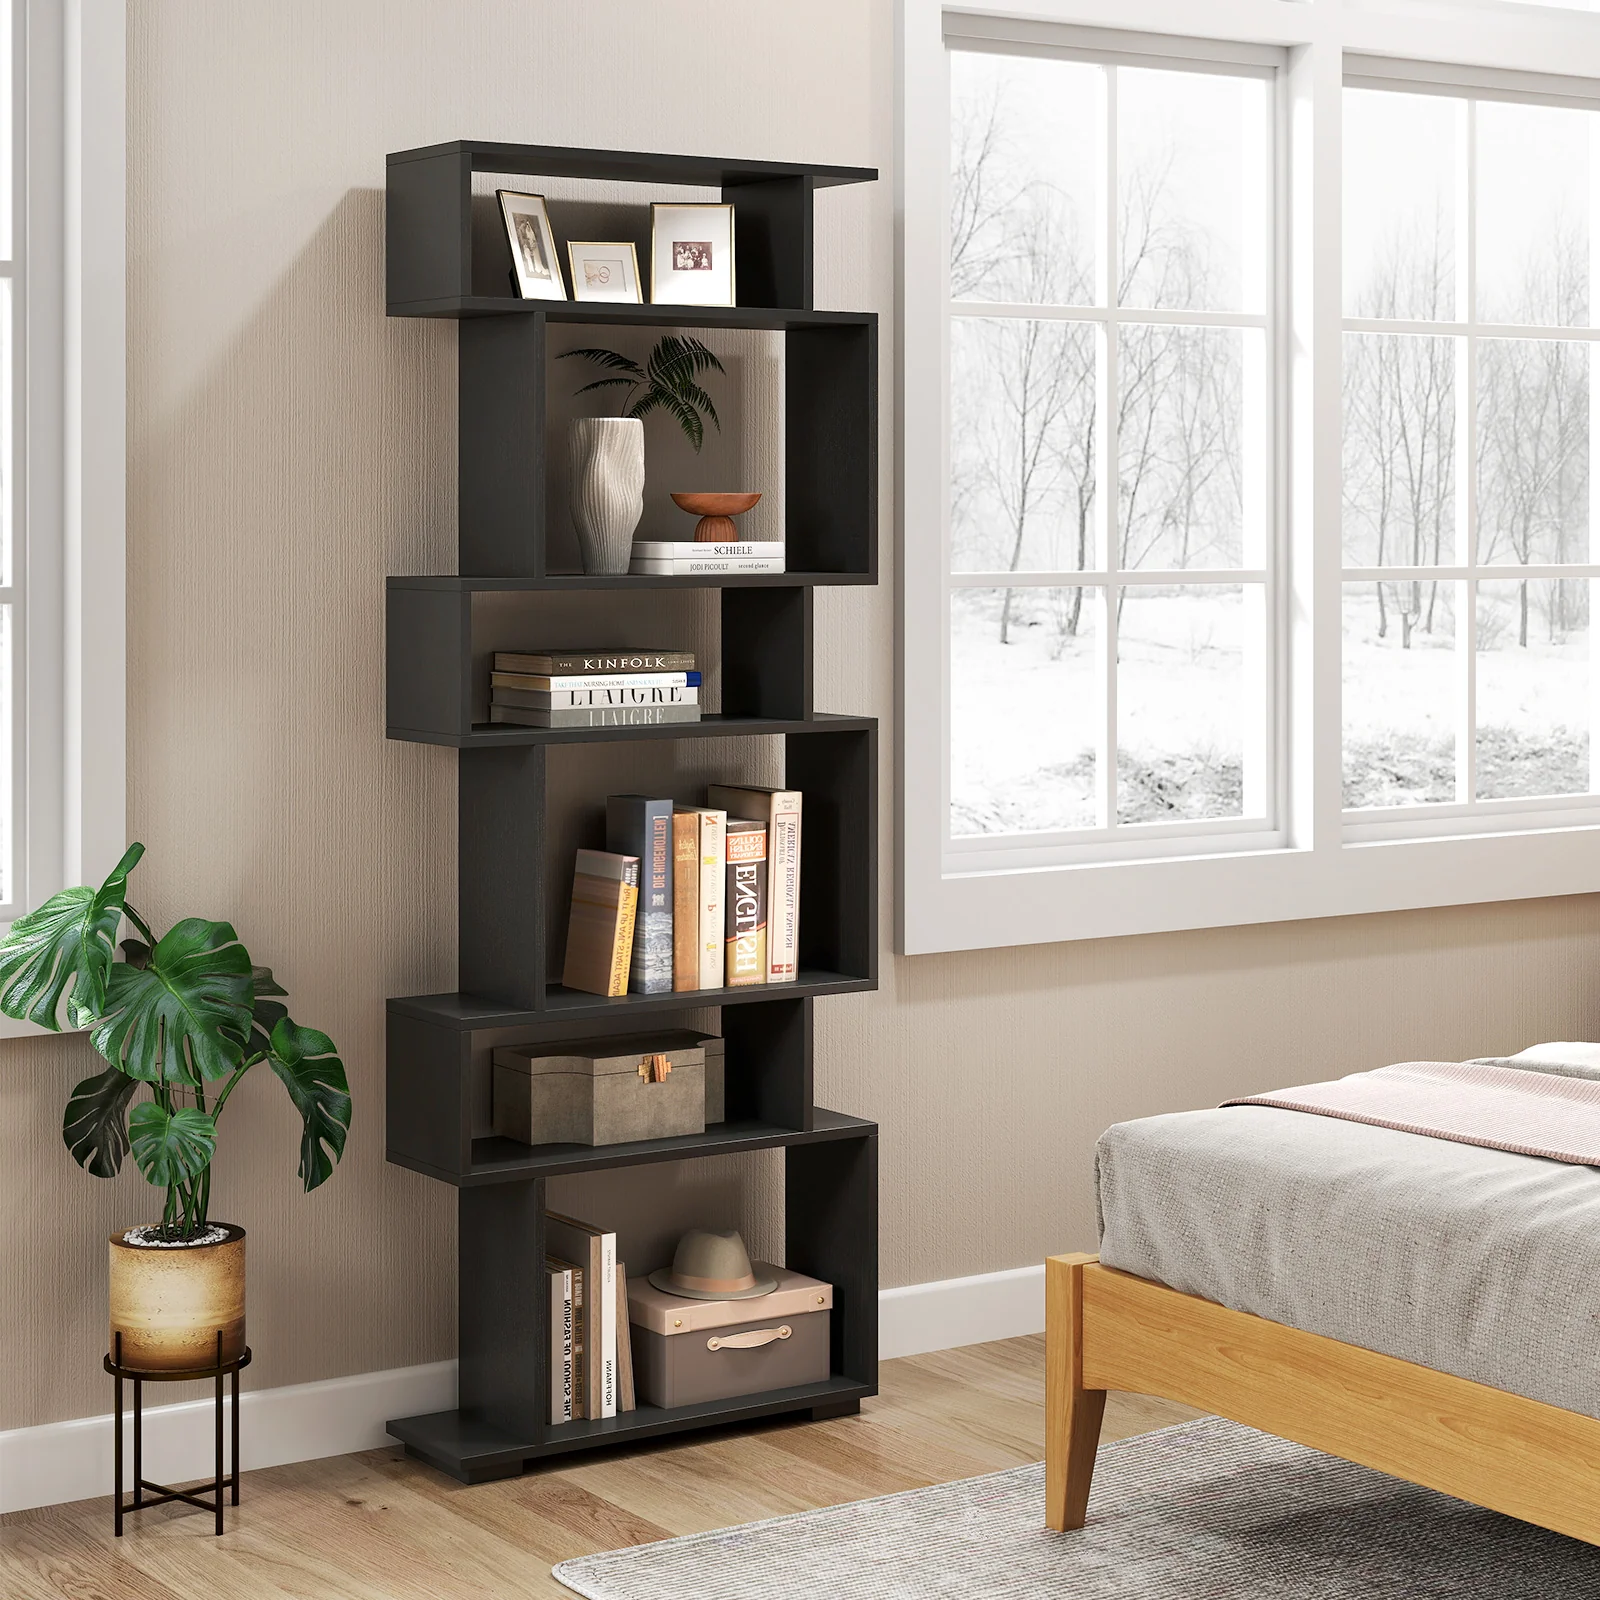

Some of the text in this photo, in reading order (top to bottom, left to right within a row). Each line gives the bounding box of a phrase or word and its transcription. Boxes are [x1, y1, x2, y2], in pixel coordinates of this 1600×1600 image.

[713, 546, 753, 555] SCHIELE
[690, 563, 729, 572] JODI PICOULT
[754, 562, 770, 570] glance
[583, 657, 667, 670] KINFOLK
[583, 680, 608, 688] NURSING
[569, 686, 683, 706] LIAIGRE
[588, 707, 666, 727] LIAIGRE
